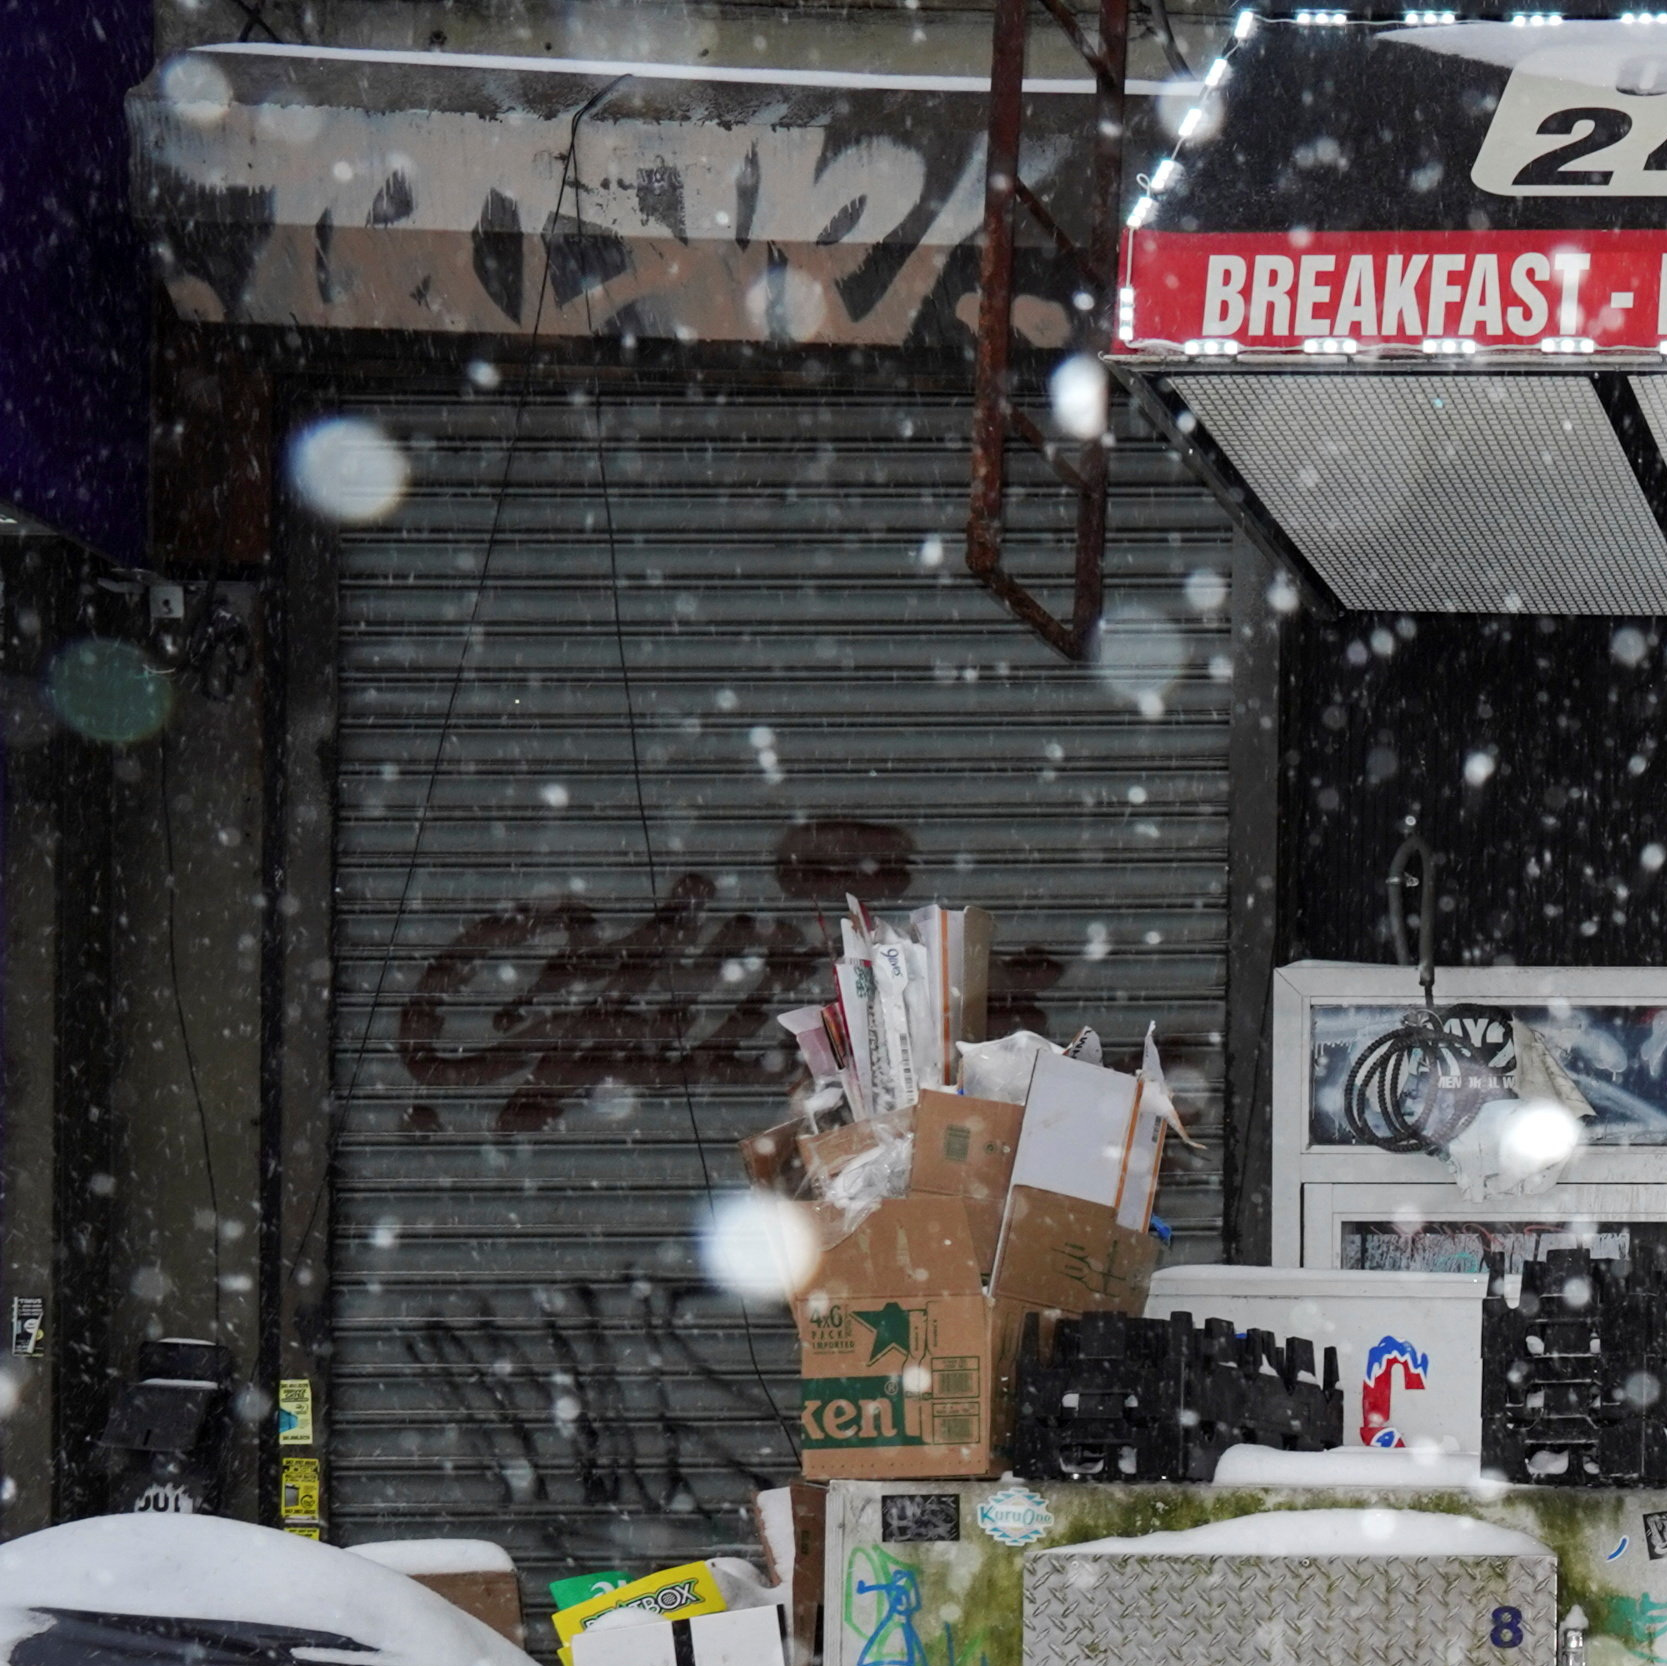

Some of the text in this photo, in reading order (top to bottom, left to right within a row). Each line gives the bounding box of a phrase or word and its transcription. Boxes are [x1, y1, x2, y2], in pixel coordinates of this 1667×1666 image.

[1203, 252, 1590, 338] BREAKFAST
[809, 1304, 843, 1328] 4x6
[810, 1330, 844, 1340] PACK
[811, 1340, 855, 1349] IMPORTED
[1489, 1605, 1523, 1649] 8
